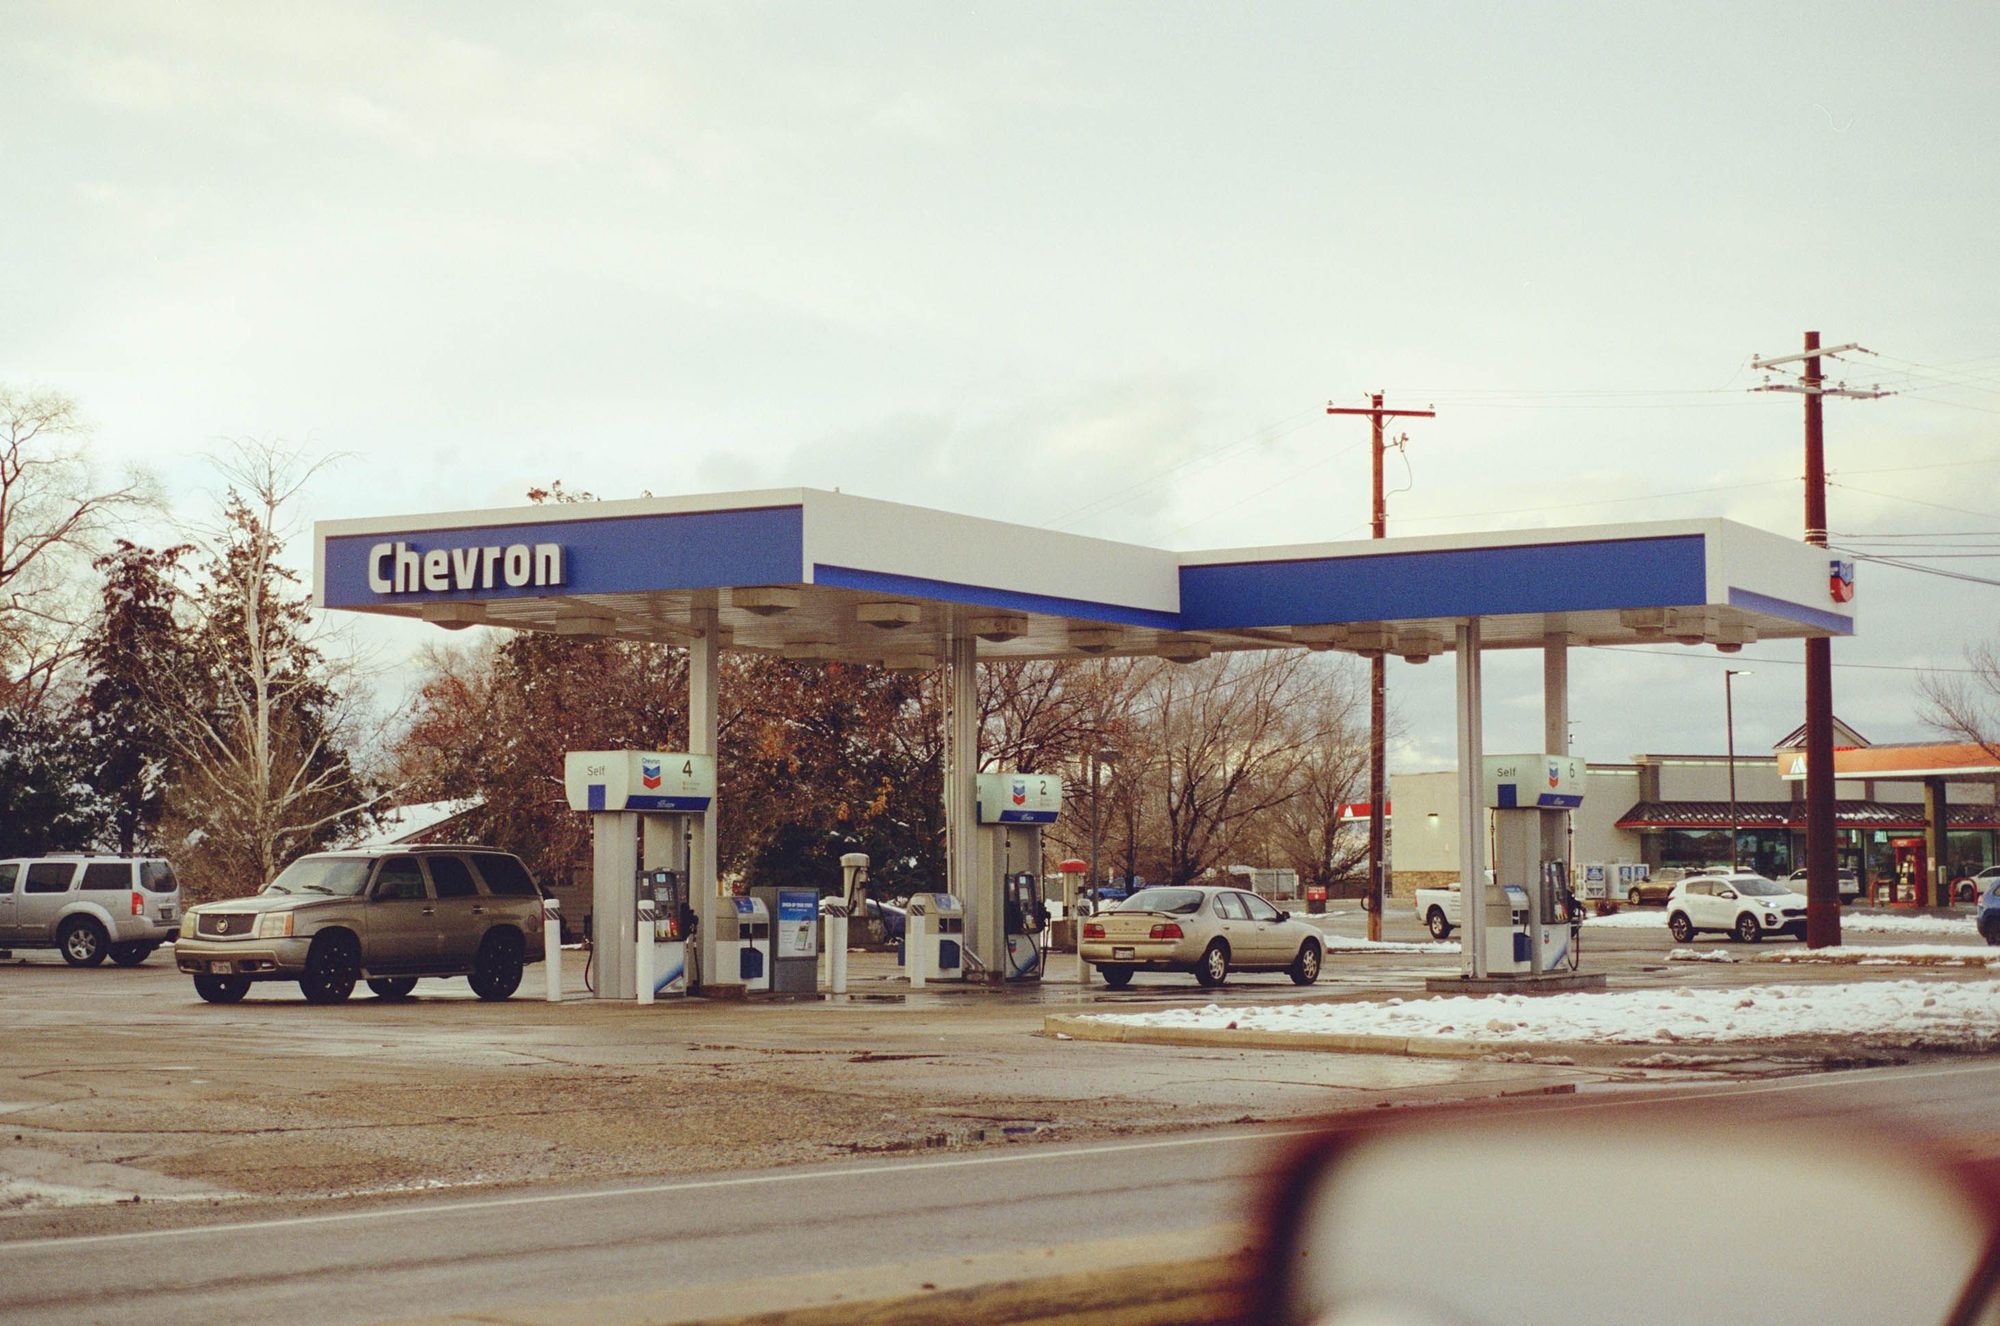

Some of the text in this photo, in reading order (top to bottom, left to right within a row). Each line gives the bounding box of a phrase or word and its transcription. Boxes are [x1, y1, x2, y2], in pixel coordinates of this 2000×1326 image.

[368, 541, 562, 594] Chevron
[587, 765, 605, 776] Self
[682, 759, 693, 778] 4
[1497, 767, 1516, 777] Self
[1569, 762, 1575, 778] 6
[1040, 780, 1047, 795] 2
